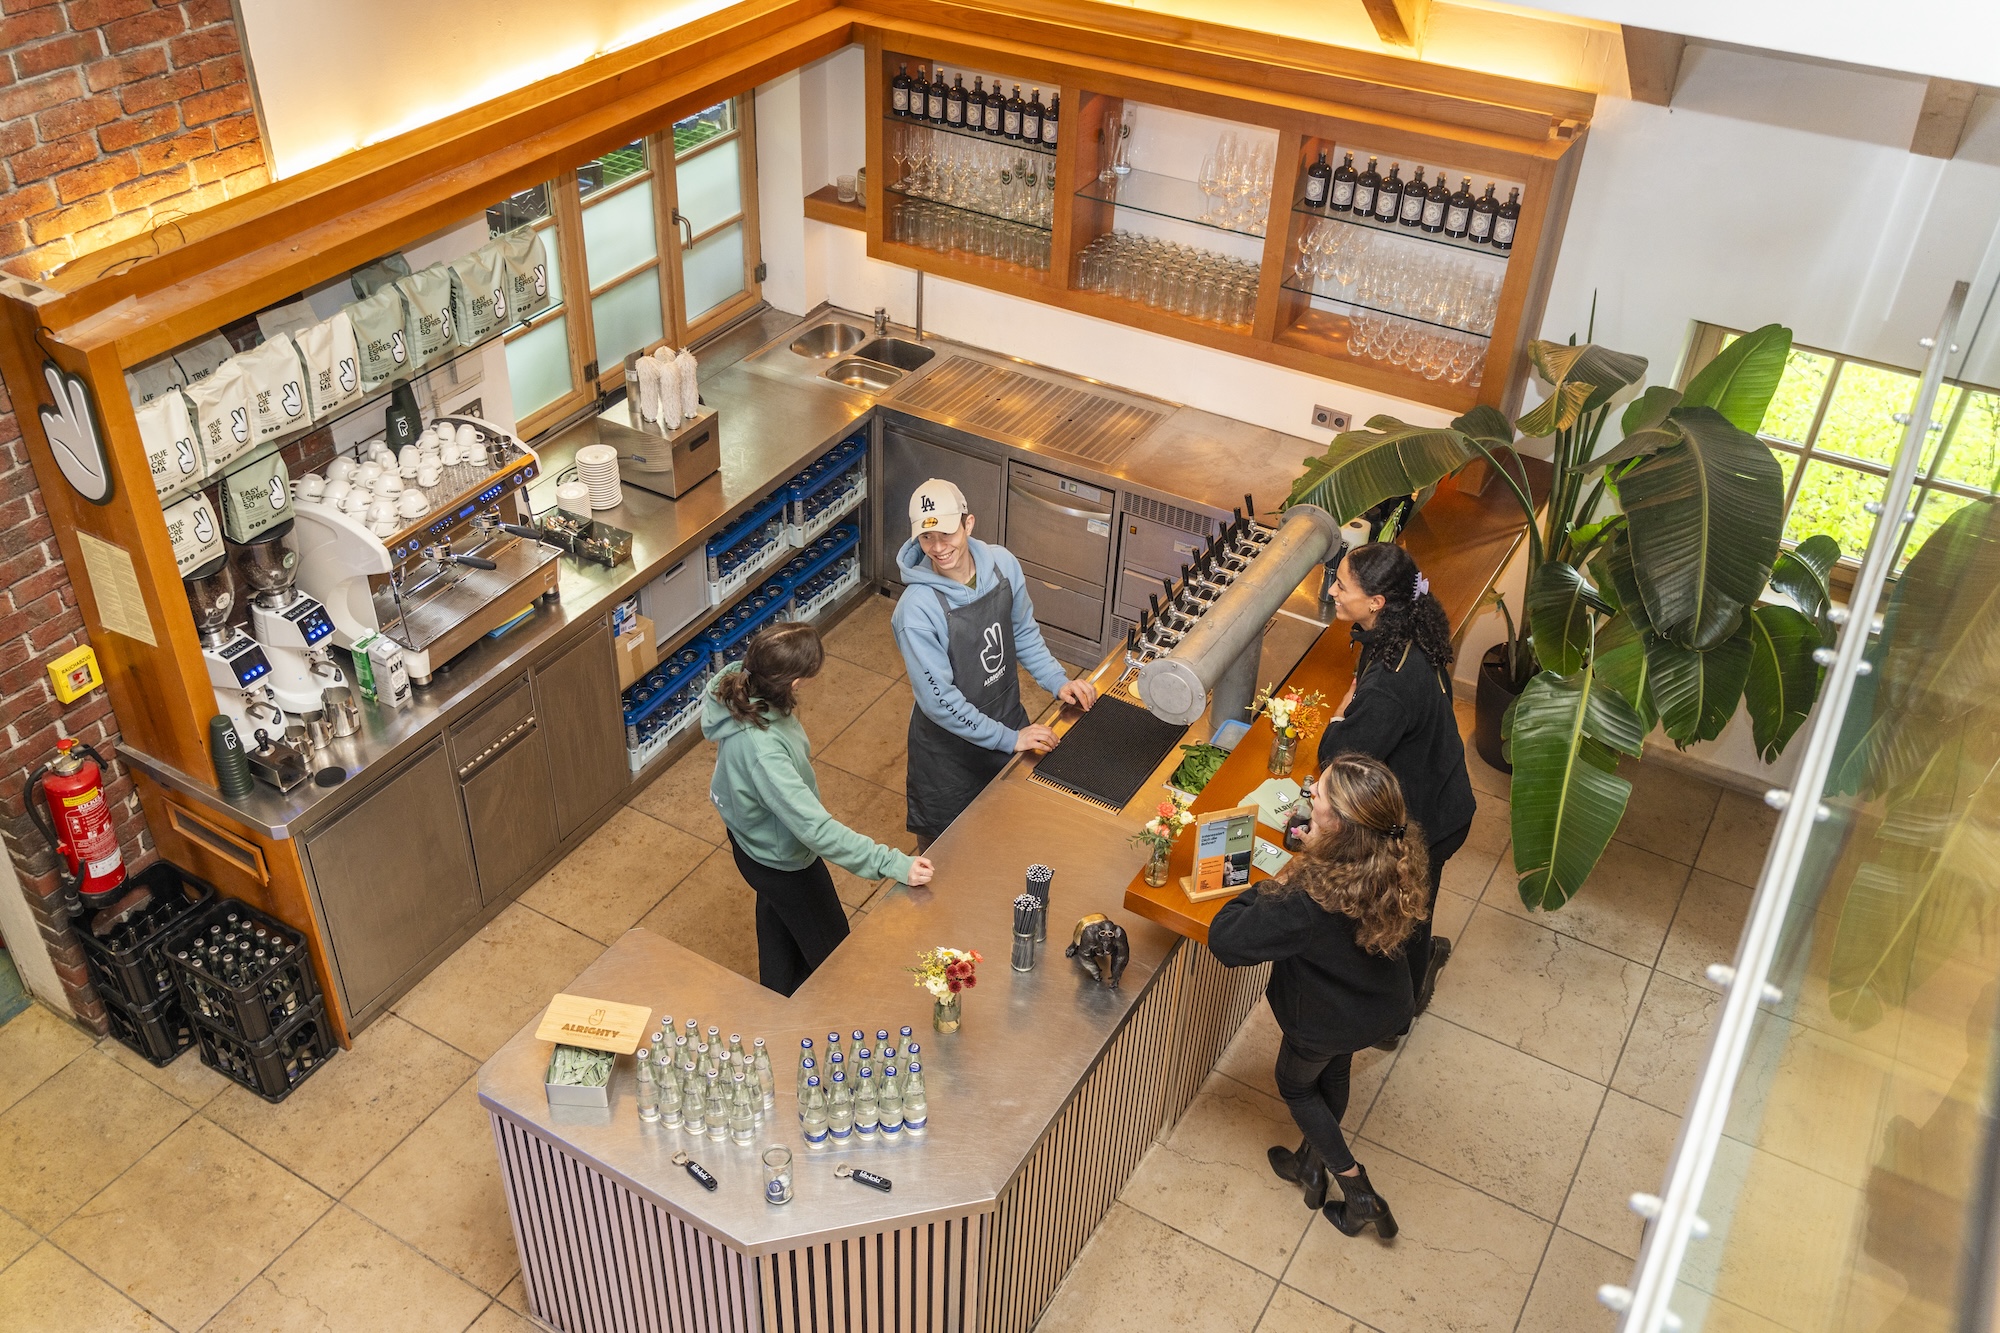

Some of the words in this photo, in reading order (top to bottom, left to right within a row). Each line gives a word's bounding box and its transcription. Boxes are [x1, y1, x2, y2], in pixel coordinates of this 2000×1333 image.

[515, 286, 525, 294] SO
[471, 294, 486, 306] EASY
[473, 309, 483, 317] SO
[420, 328, 431, 336] SO
[367, 338, 382, 351] EASY
[368, 342, 391, 357] ESPRES
[369, 354, 380, 363] SO
[320, 383, 332, 392] MA
[212, 435, 222, 445] MA
[149, 449, 168, 462] TRUE
[151, 458, 167, 469] CRE
[152, 465, 167, 475] MA
[239, 486, 260, 497] EASY
[242, 489, 269, 504] ESPRES
[243, 501, 255, 510] SO
[920, 494, 935, 513] LA
[166, 519, 184, 533] TRUE
[169, 527, 183, 539] CRE
[171, 535, 184, 546] MA
[61, 654, 91, 674] RAUCHABZUG
[983, 664, 1006, 687] ALRIGHTY
[924, 668, 940, 697] TWO
[939, 698, 979, 731] COLORS
[561, 1023, 620, 1038] ALRIGHTY
